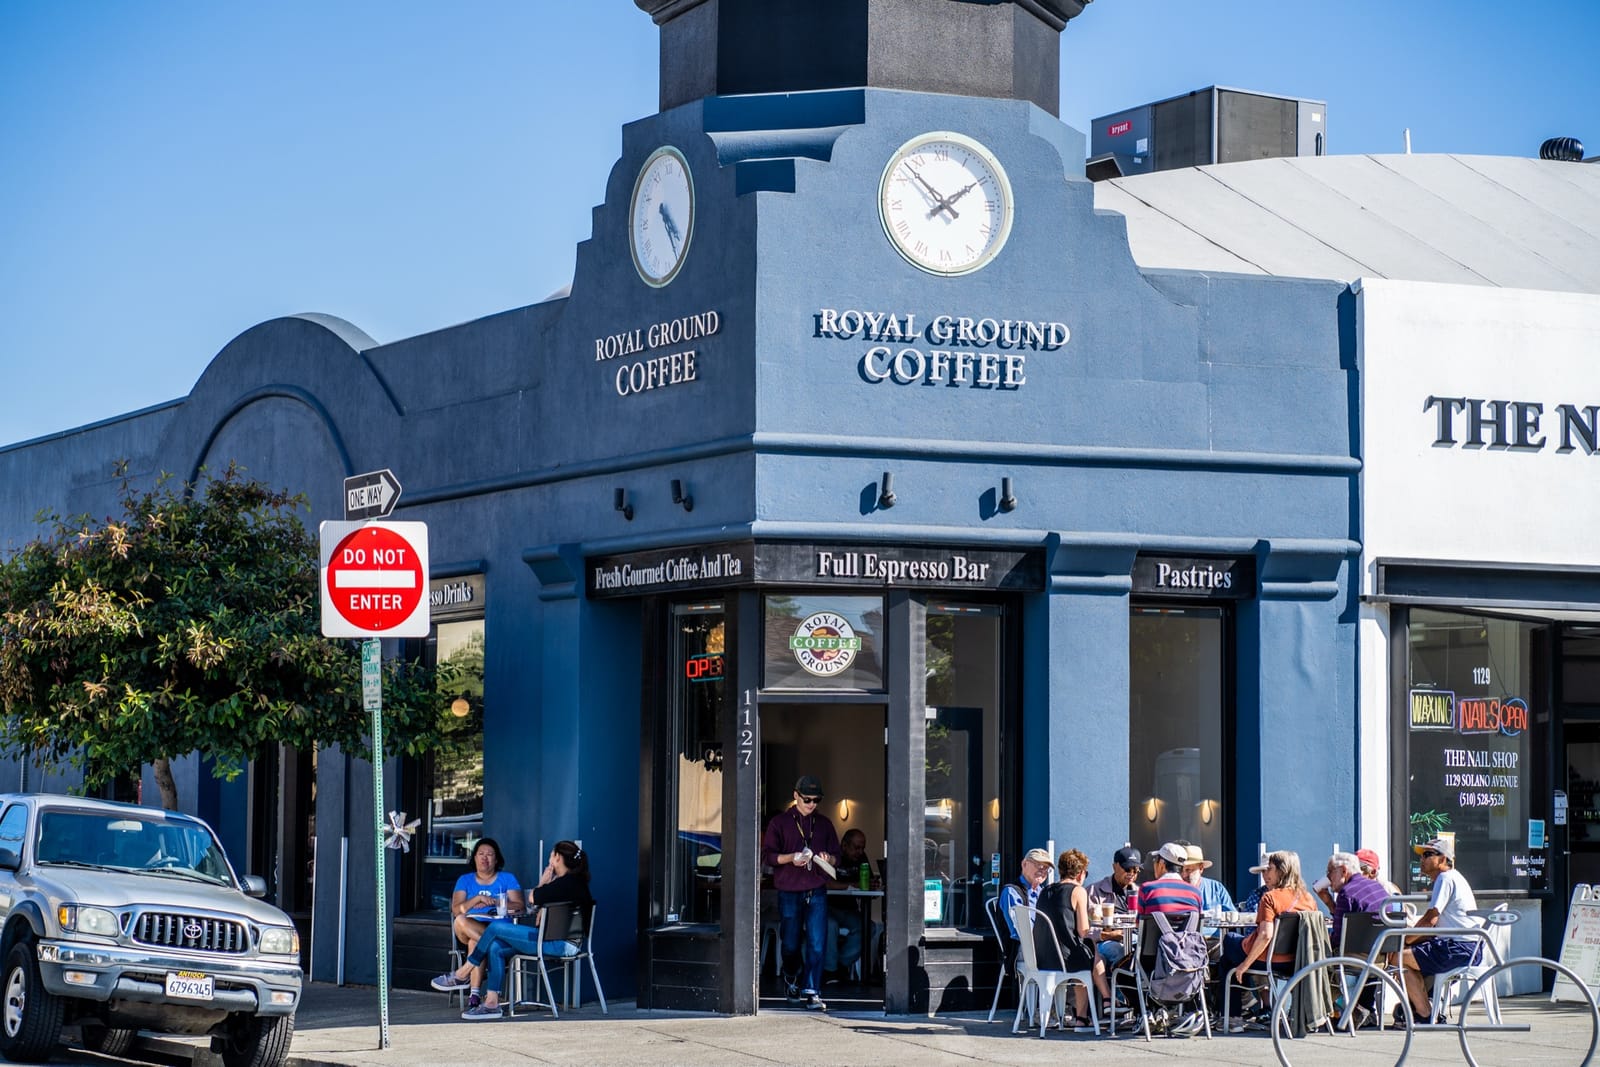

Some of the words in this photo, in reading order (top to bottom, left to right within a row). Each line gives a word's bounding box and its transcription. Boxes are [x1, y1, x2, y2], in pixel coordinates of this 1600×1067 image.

[1112, 122, 1128, 134] bryant
[596, 329, 644, 361] ROYAL
[648, 310, 718, 348] GROUND
[820, 308, 922, 338] ROYAL
[932, 315, 1070, 346] GROUND
[616, 350, 696, 396] COFFEE
[865, 346, 1026, 386] COFFEE
[1423, 395, 1546, 453] THE
[1555, 404, 1600, 456] N
[350, 490, 364, 508] ONE
[366, 486, 382, 506] WAY
[344, 549, 366, 564] DO
[373, 549, 406, 564] NOT
[818, 552, 859, 576] Full
[864, 553, 948, 584] Espresso
[952, 556, 990, 580] Bar
[595, 566, 622, 590] Fresh
[622, 562, 665, 586] Gourmet
[666, 558, 698, 582] Coffee
[700, 554, 721, 579] And
[722, 554, 741, 577] Tea
[1157, 562, 1232, 588] Pastries
[350, 594, 402, 610] ENTER
[444, 582, 472, 605] Drinks
[804, 616, 846, 633] ROYAL
[794, 638, 858, 648] COFFEE
[801, 651, 850, 672] GROUND
[1473, 667, 1490, 684] 1129
[1412, 695, 1452, 724] WAXING
[1461, 702, 1498, 730] NAILS
[1501, 704, 1528, 730] OPEN
[742, 690, 752, 766] 1127
[1444, 749, 1466, 767] THE
[1467, 750, 1490, 768] NAIL
[1492, 751, 1518, 769] SHOP
[1445, 774, 1460, 786] 1129
[1462, 774, 1490, 787] SOLANO
[1492, 776, 1518, 788] AVENUE
[1460, 792, 1476, 806] (510)
[1477, 793, 1504, 807] 528-5528
